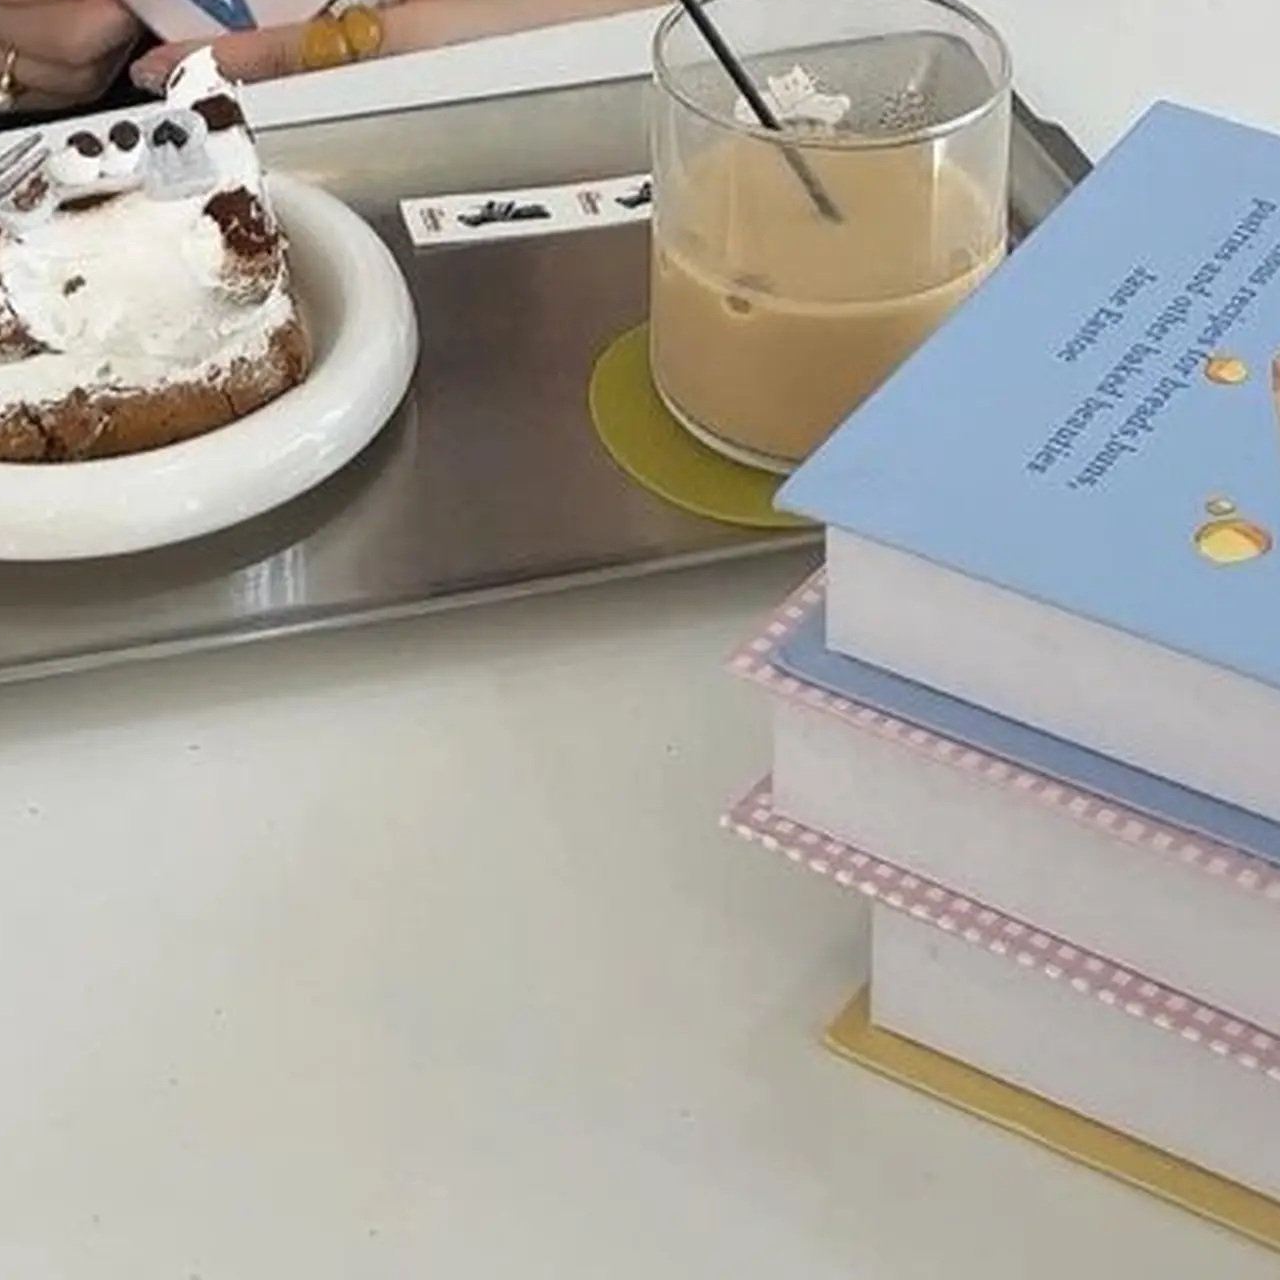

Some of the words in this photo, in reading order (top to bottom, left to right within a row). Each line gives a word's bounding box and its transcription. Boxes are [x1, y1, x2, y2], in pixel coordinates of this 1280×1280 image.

[1108, 266, 1158, 306] Jane
[1185, 262, 1221, 297] and
[1144, 295, 1192, 341] other
[1095, 343, 1158, 398] baked
[1172, 347, 1210, 377] for
